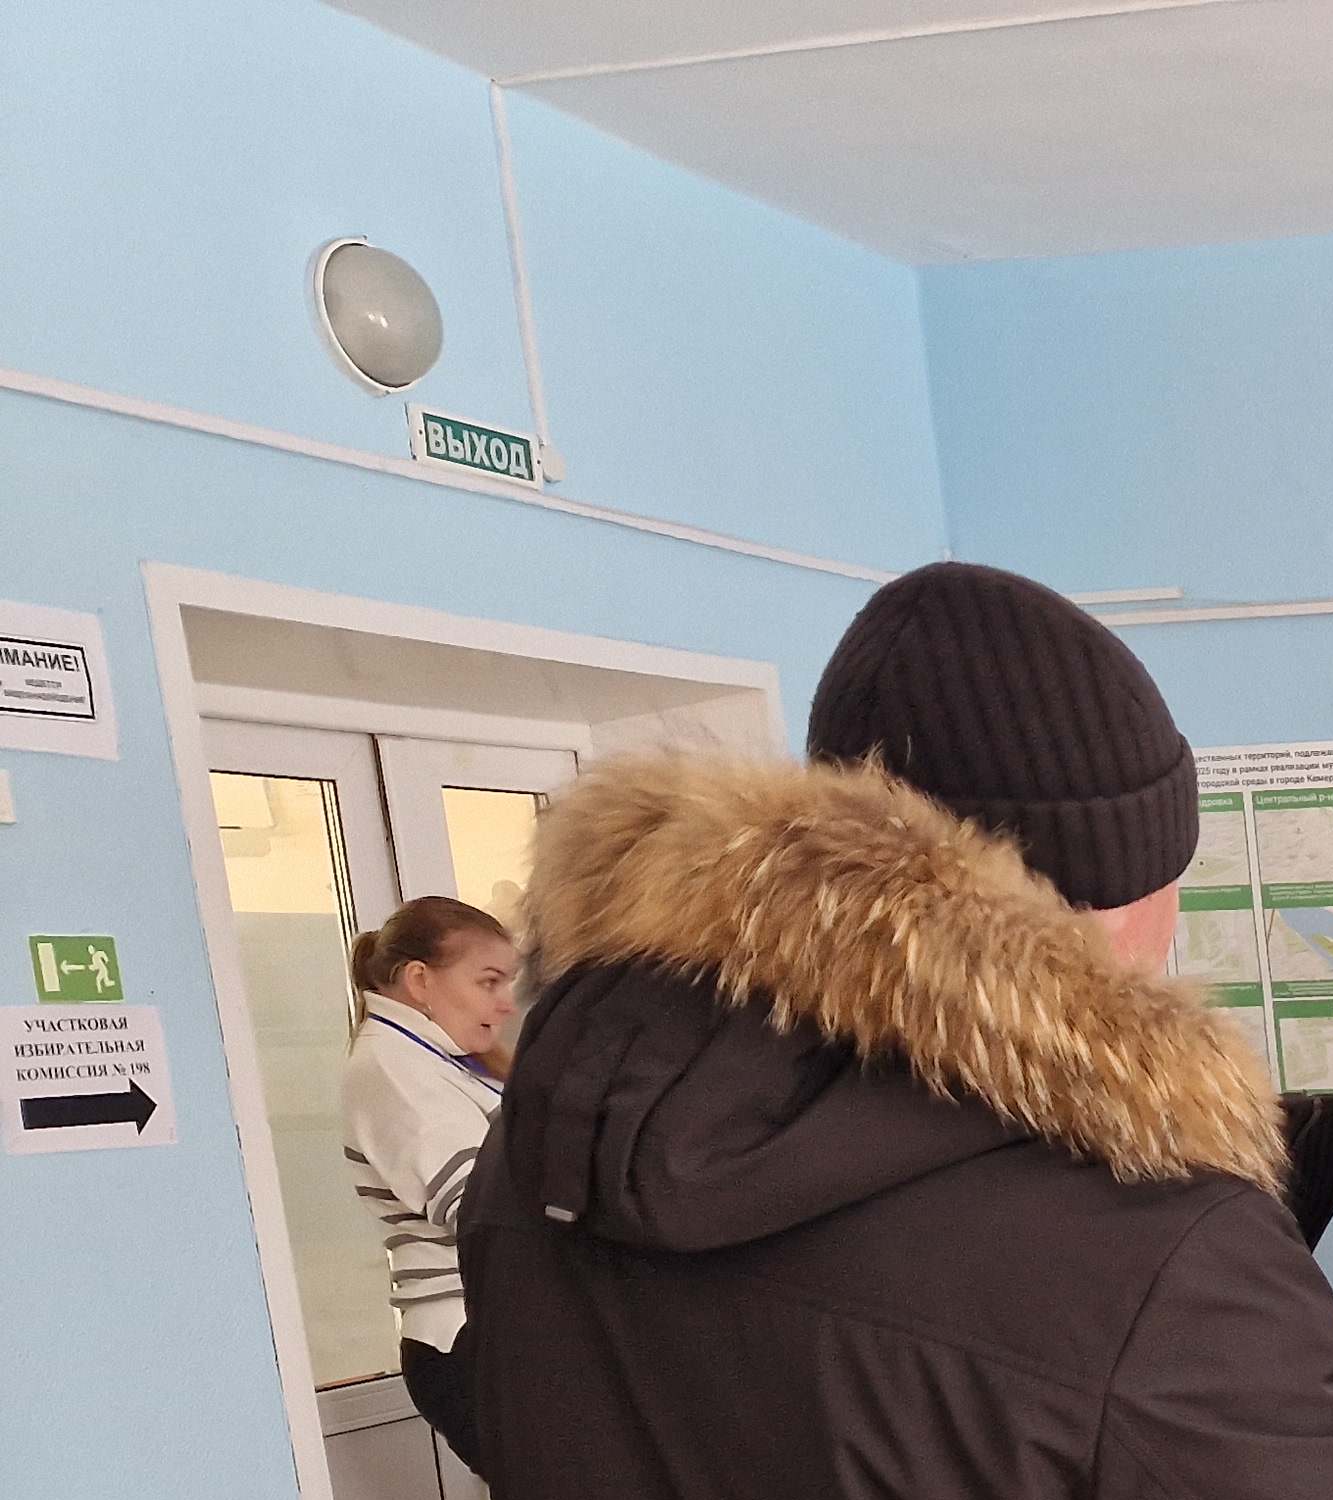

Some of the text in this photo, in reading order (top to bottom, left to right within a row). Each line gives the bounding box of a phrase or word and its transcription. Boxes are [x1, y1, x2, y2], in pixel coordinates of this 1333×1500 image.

[425, 420, 530, 480] ВЫХОД
[1212, 767, 1230, 776] году
[1240, 765, 1269, 774] рамках
[1242, 778, 1268, 787] среды
[1276, 776, 1305, 785] городе
[23, 1016, 129, 1033] УЧАСТКОВАЯ
[13, 1039, 145, 1058] ИЗБИРАТЕЛЬНАЯ
[16, 1062, 150, 1081] КОМИССИЯ № 198
